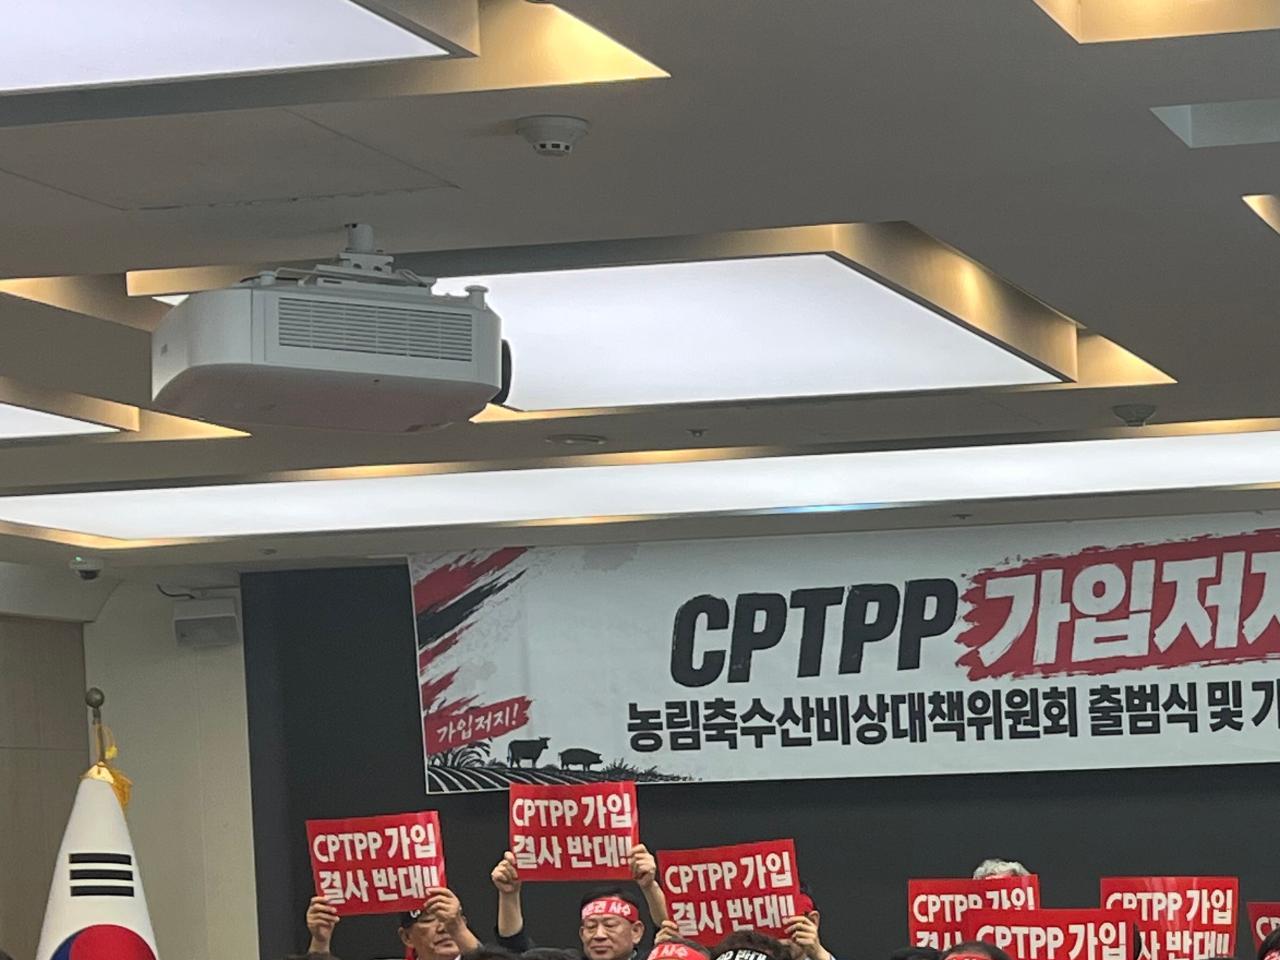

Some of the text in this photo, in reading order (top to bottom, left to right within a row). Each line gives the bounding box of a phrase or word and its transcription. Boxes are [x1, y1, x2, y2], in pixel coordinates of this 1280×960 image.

[669, 578, 957, 688] CPTPP
[627, 688, 1077, 754] 농림축수산비상대책위원회
[1088, 682, 1197, 738] 출범식
[1208, 676, 1244, 732] 및
[513, 793, 632, 828] CPTPP 가입
[313, 823, 437, 863] CPTPP 가입
[513, 835, 633, 870] 결사 반대!!
[319, 865, 440, 904] 결사 반대!!
[664, 851, 794, 894] CPTPP 가입
[671, 894, 795, 937] 결사 반대!!
[1186, 889, 1233, 925] 가입
[976, 924, 1064, 960] CPTPP
